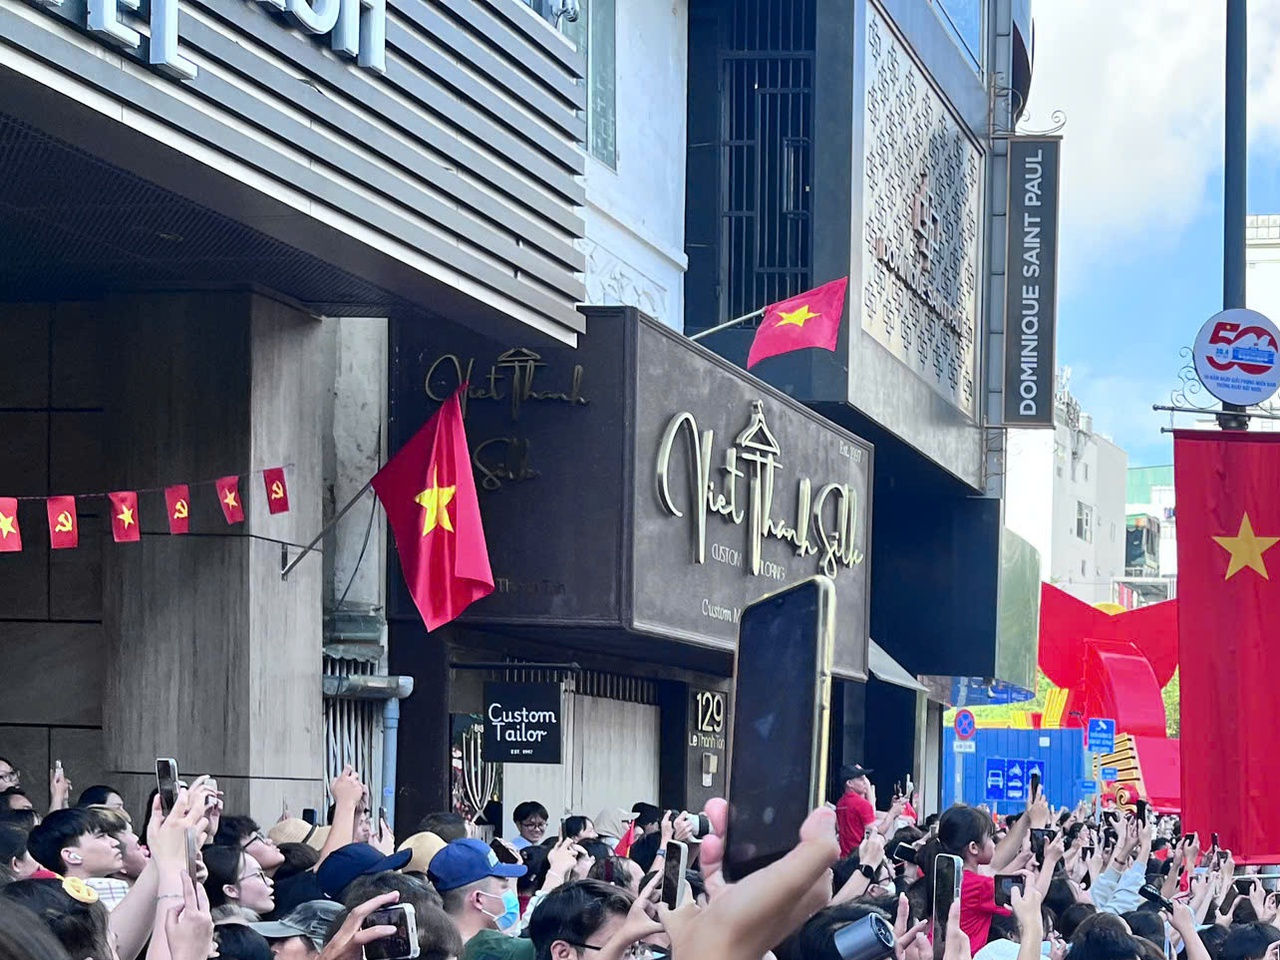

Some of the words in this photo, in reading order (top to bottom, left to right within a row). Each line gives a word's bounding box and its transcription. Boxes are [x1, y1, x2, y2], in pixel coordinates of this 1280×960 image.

[1025, 149, 1043, 207] PAUL
[1023, 213, 1041, 278] SAINT
[1019, 285, 1040, 416] DOMINIQUE
[1206, 322, 1279, 375] 50
[657, 412, 745, 564] Viet
[741, 451, 818, 576] Thanh
[813, 483, 863, 579] Silk
[711, 543, 742, 567] CUSTOM
[702, 599, 732, 623] Custom
[488, 703, 556, 725] Custom
[492, 721, 547, 743] Tailor
[697, 691, 724, 732] 129
